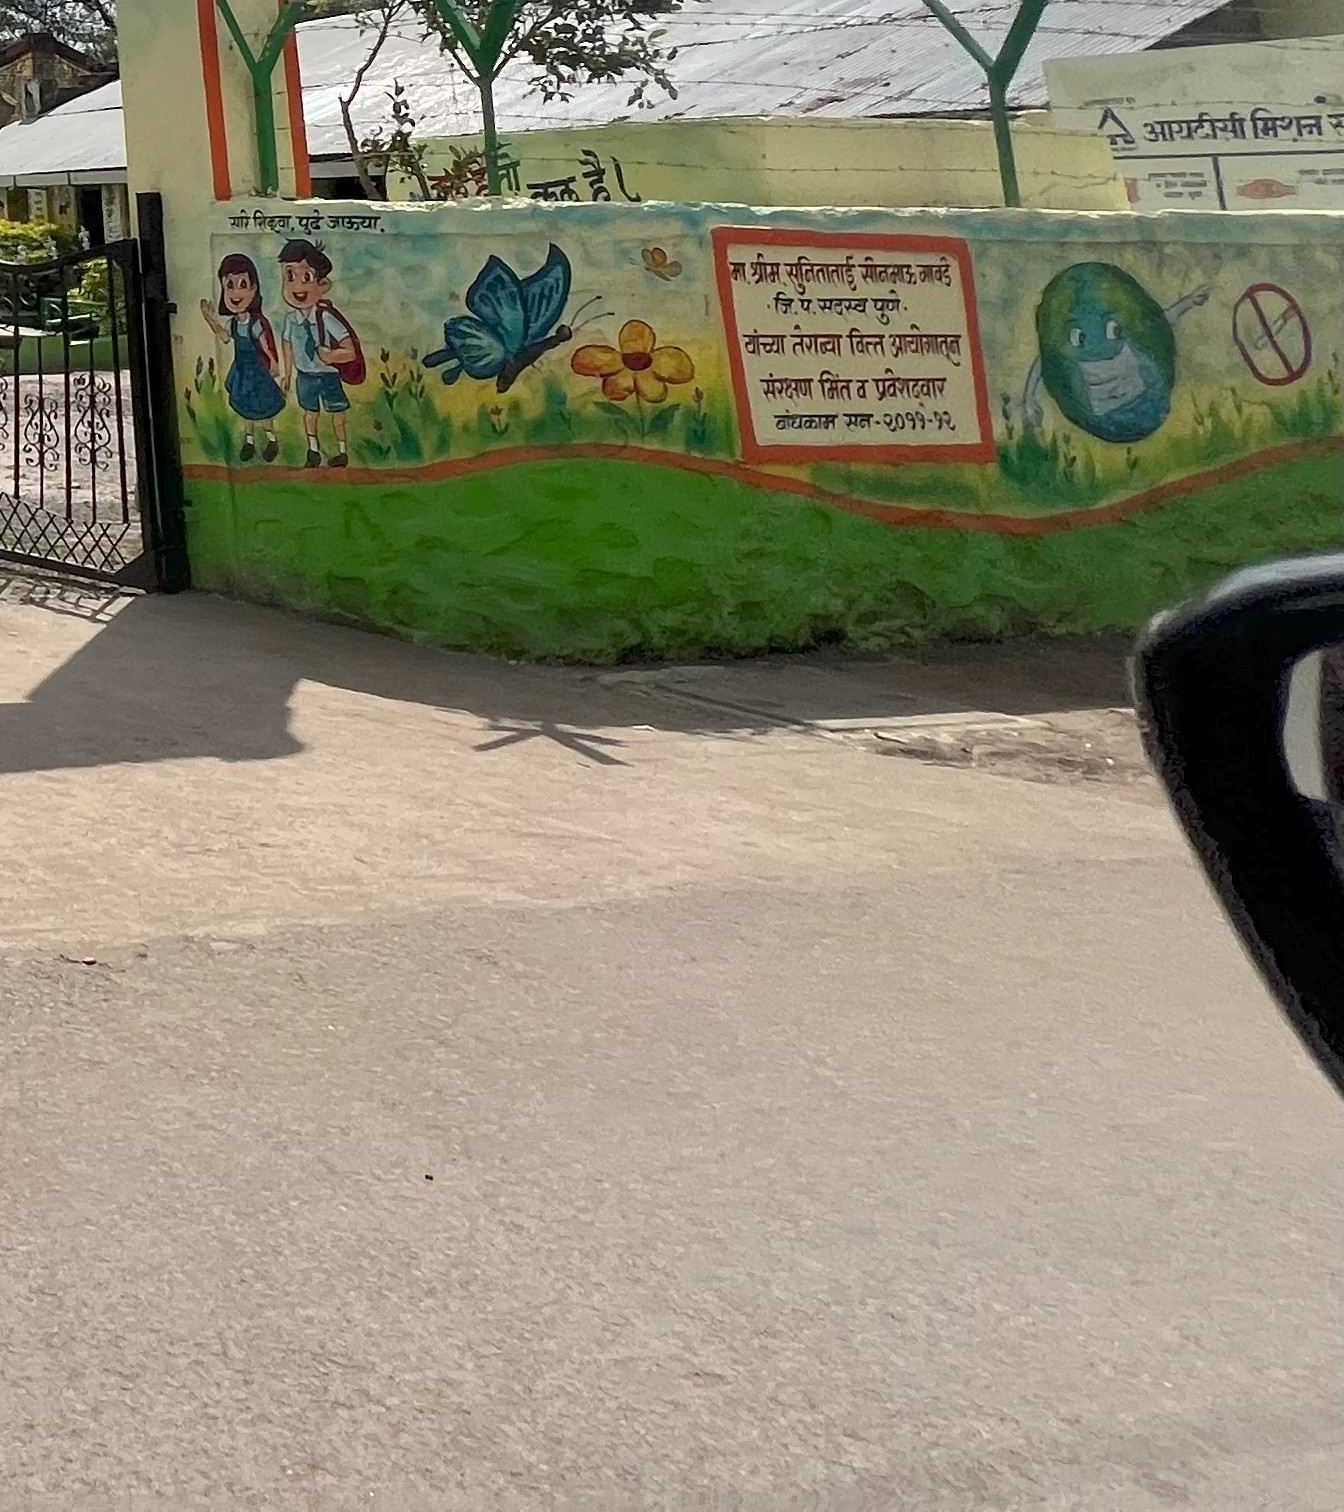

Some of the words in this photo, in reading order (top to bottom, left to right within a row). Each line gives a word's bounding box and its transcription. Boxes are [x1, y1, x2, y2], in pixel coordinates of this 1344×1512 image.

[295, 208, 325, 236] पुढे
[916, 255, 955, 288] गावडे
[816, 296, 870, 318] सदस्य
[742, 329, 788, 358] यांच्या
[846, 327, 886, 358] वित्त
[888, 323, 962, 367] आयोगातून
[759, 372, 814, 402] संरक्षण
[854, 377, 869, 400] व
[773, 408, 839, 432] बांधकाम
